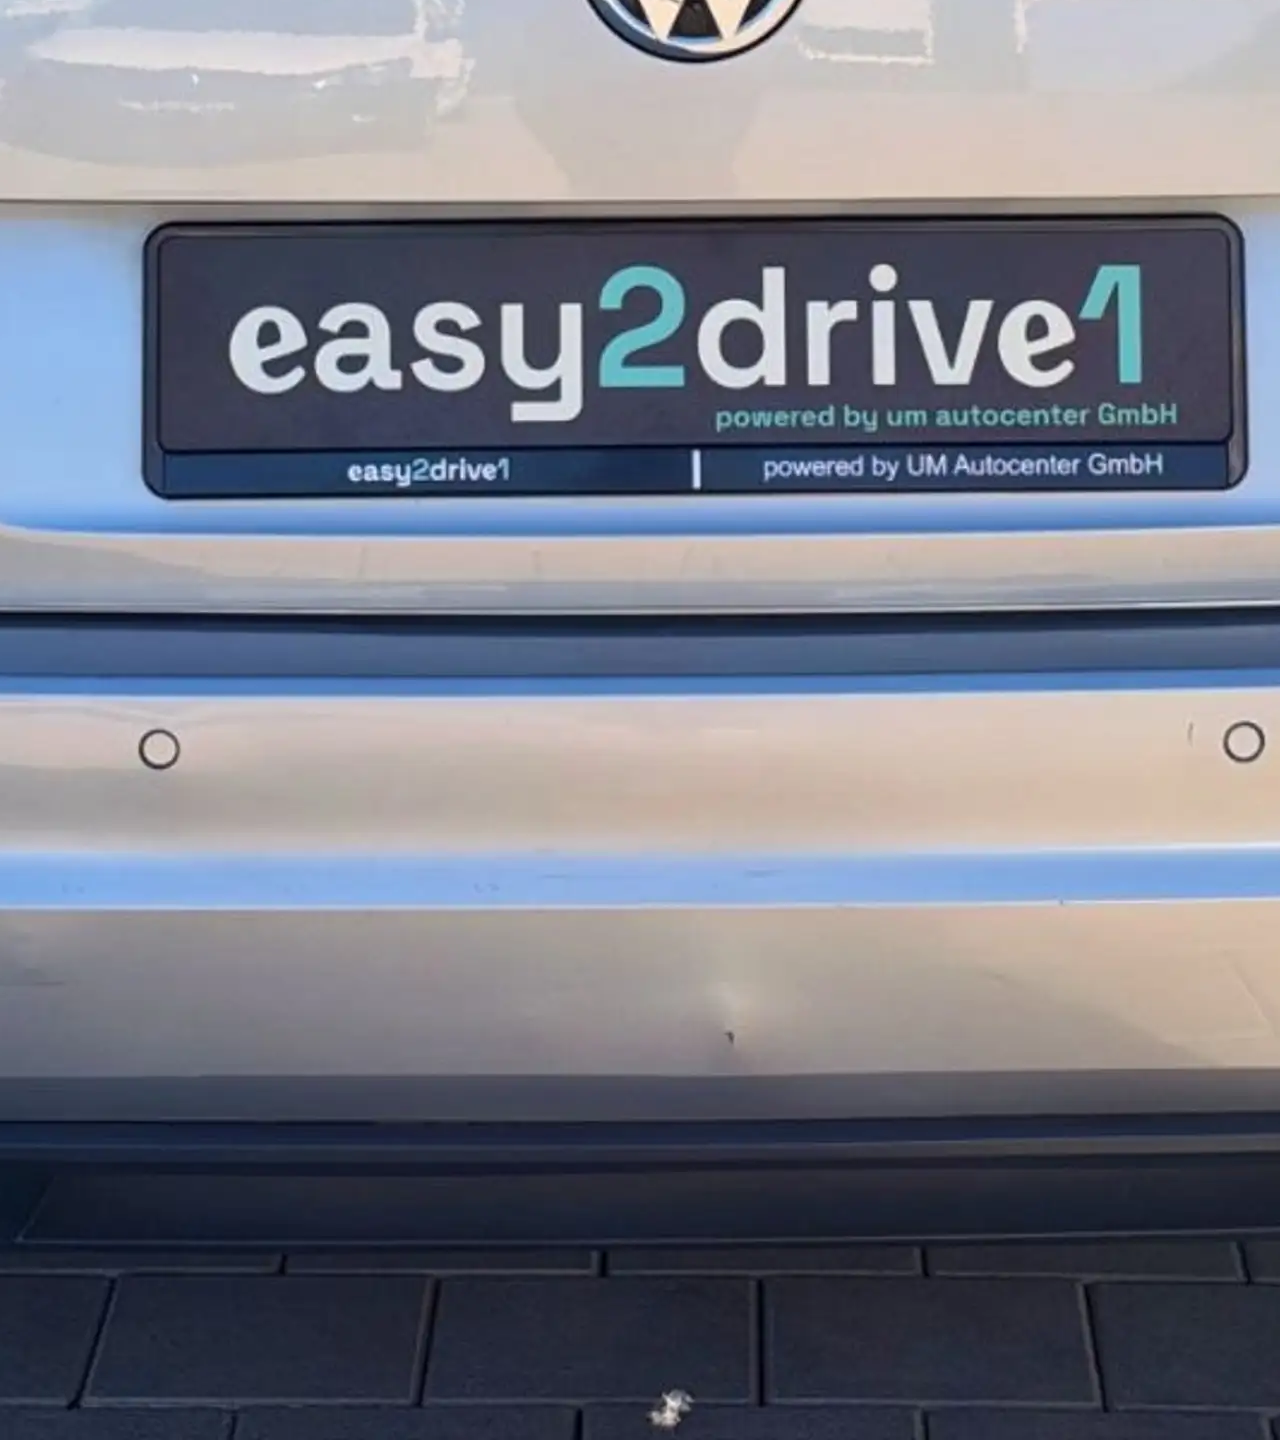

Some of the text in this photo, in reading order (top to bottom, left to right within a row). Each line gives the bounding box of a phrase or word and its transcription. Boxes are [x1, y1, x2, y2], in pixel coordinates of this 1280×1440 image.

[228, 263, 1142, 422] easy2drive1
[716, 403, 1177, 432] powered by um autocenter GmbH
[347, 457, 510, 488] easy2drive1
[763, 453, 1164, 482] powered by UM Autocenter GmbH
